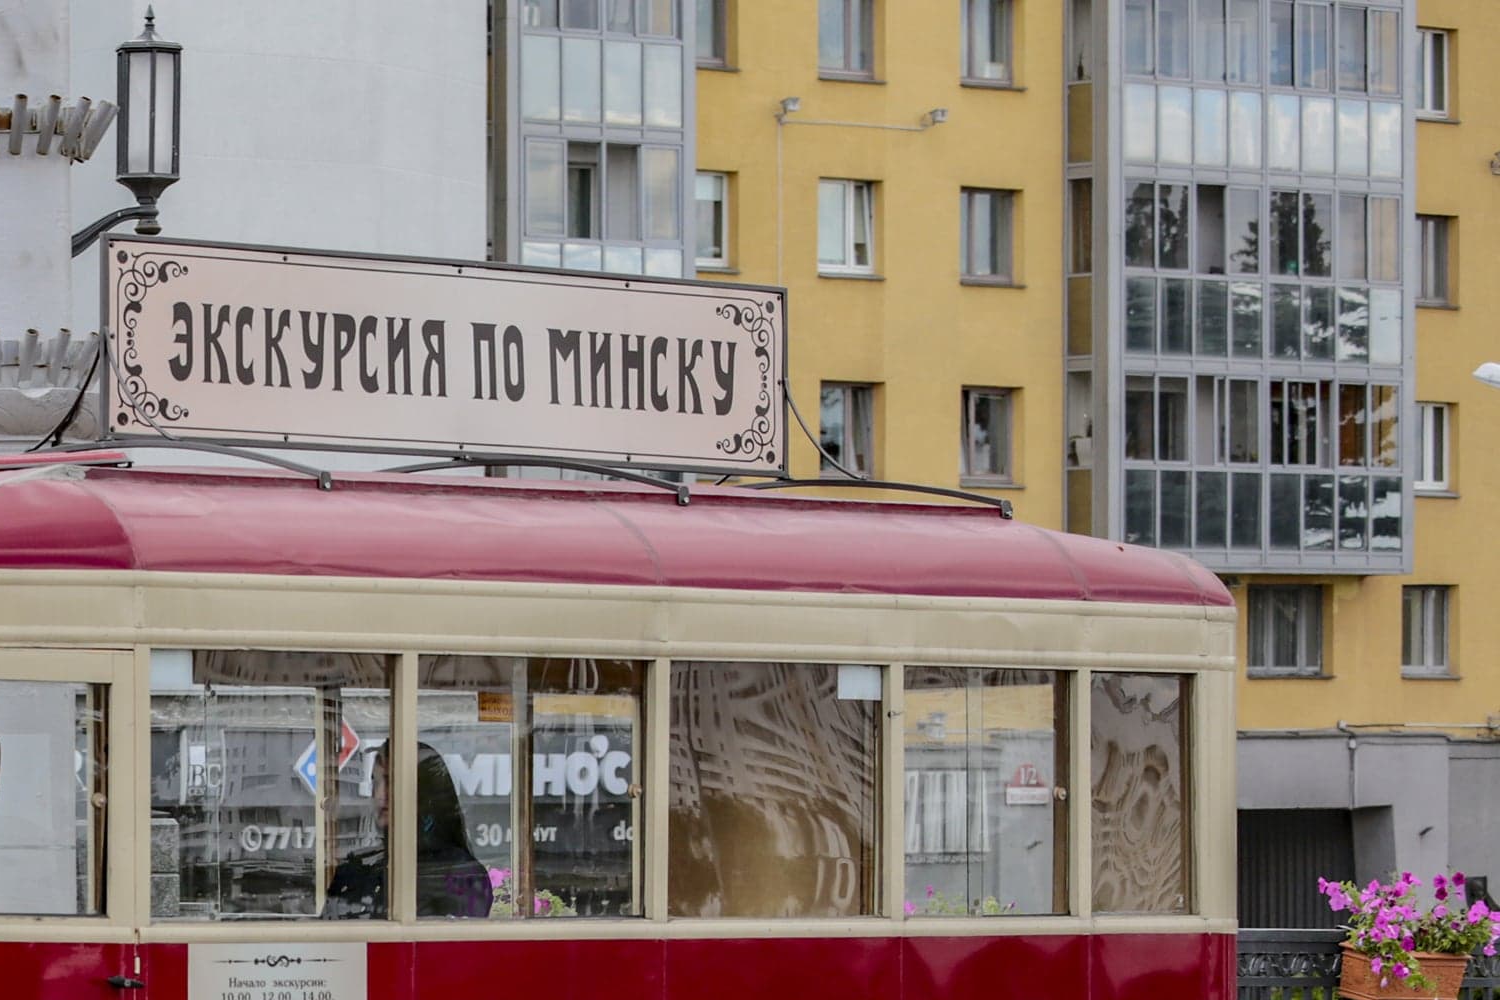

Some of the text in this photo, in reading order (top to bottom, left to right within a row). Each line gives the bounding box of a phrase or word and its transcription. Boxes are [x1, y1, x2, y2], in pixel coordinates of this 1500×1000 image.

[168, 301, 738, 417] ЭКСКУРСИЯ ПО МИНСКУ
[475, 823, 502, 848] 30
[228, 977, 267, 989] Начало
